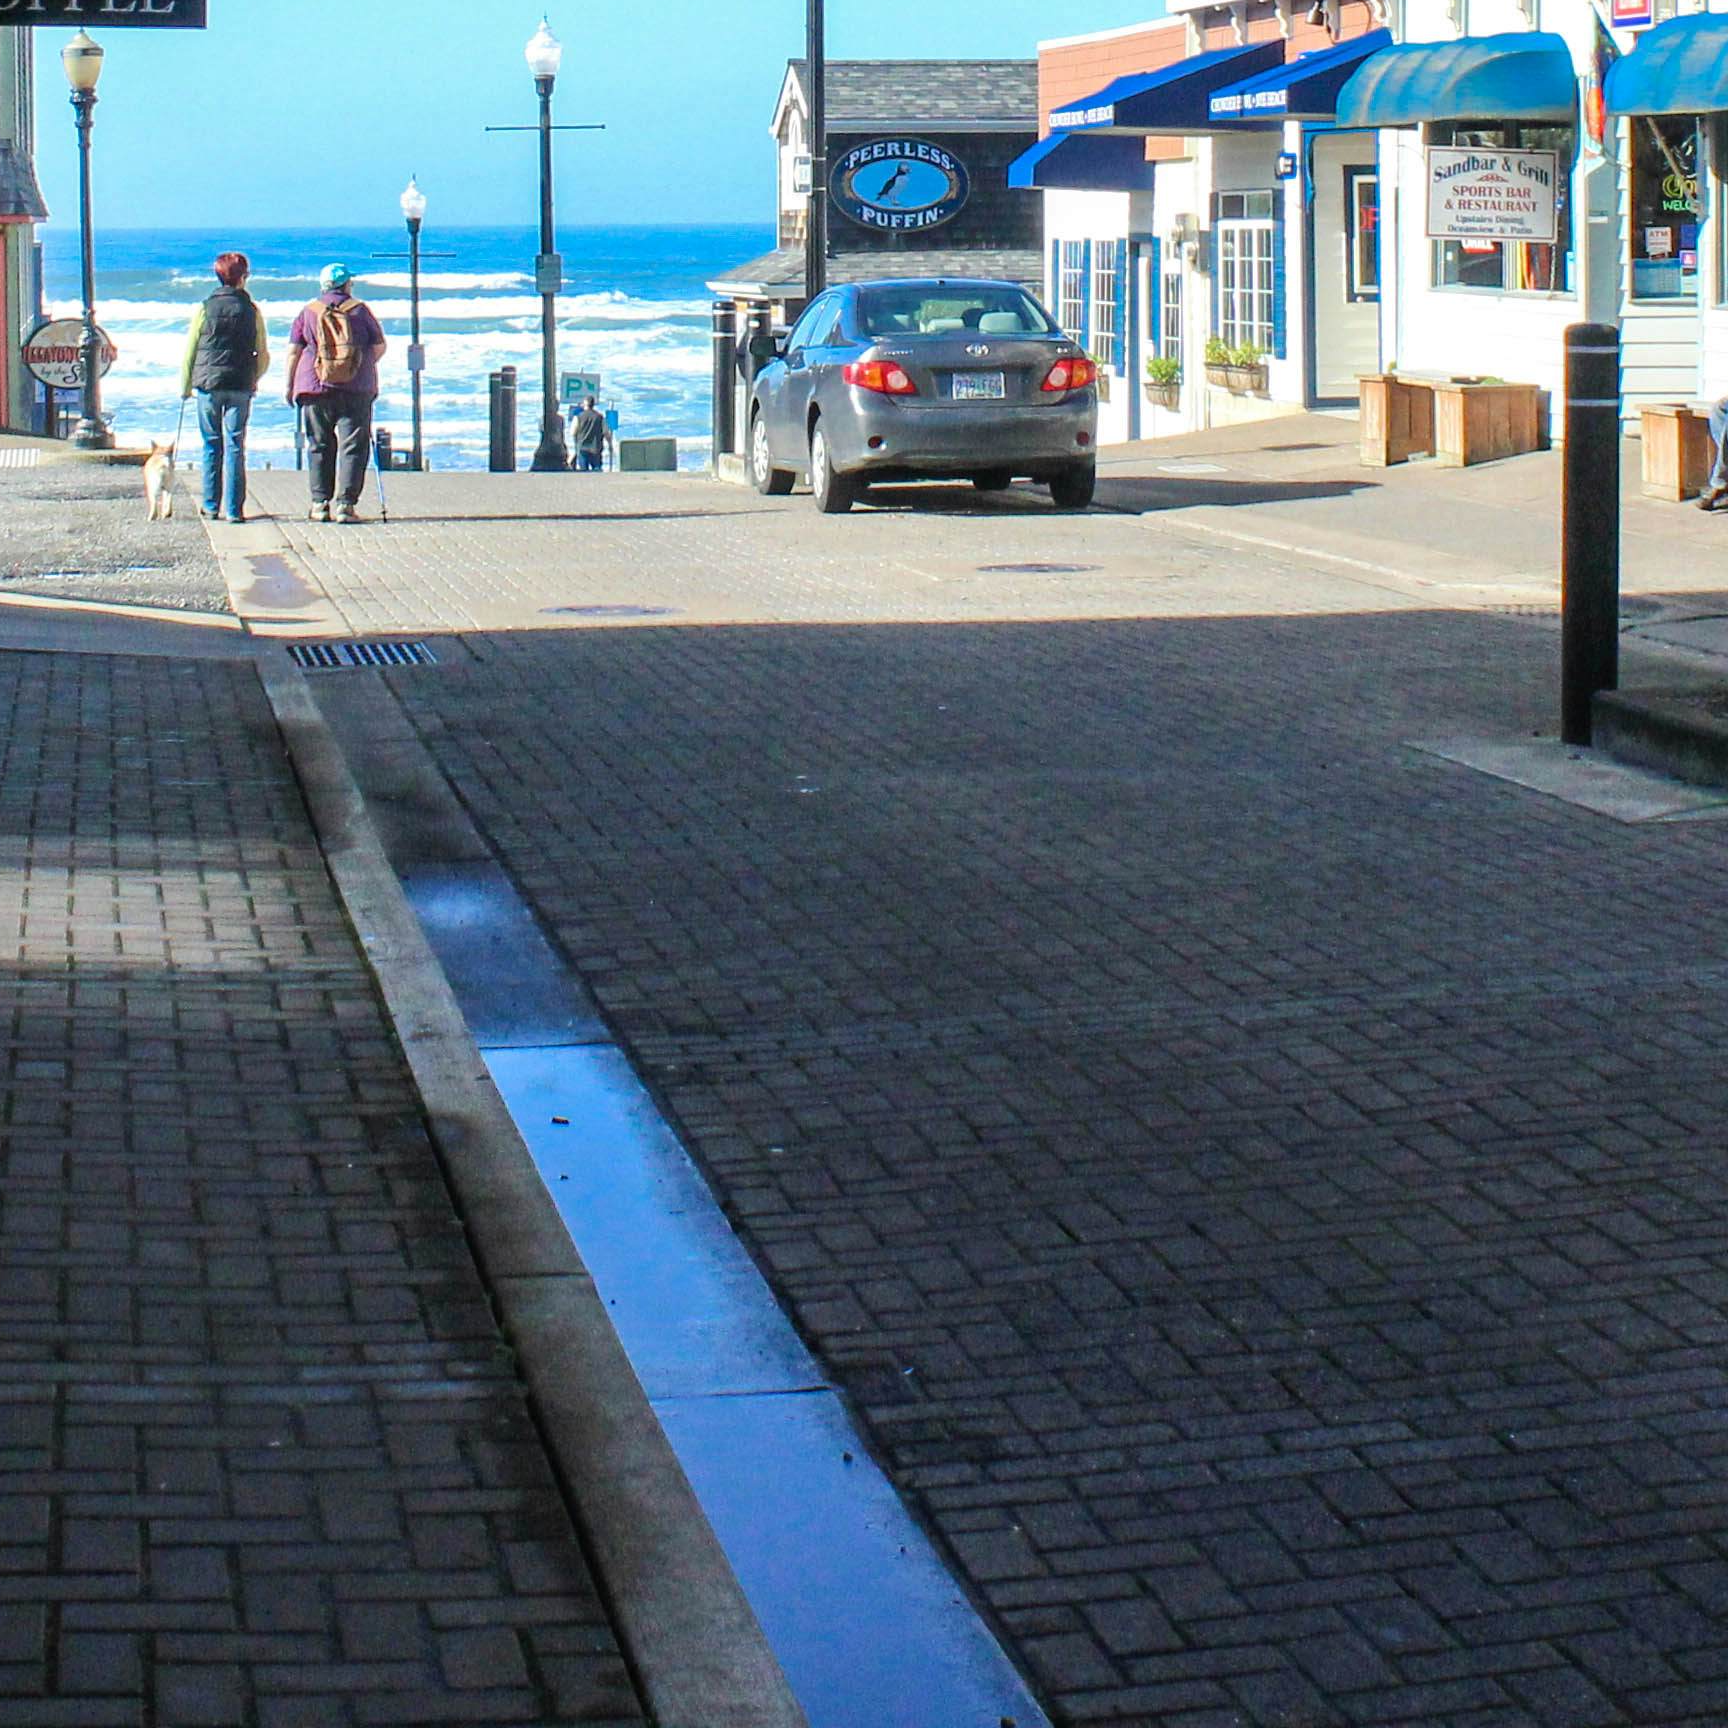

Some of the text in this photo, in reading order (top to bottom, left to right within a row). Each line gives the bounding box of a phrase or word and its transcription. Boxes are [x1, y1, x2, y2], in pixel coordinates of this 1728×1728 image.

[848, 142, 953, 170] PEERLESS
[1433, 155, 1550, 187] Sandbar & Grill
[1452, 185, 1532, 199] SPORTS BAR
[1444, 199, 1538, 212] & RESTAURANT
[861, 207, 940, 228] PUFFIN
[566, 378, 583, 398] P
